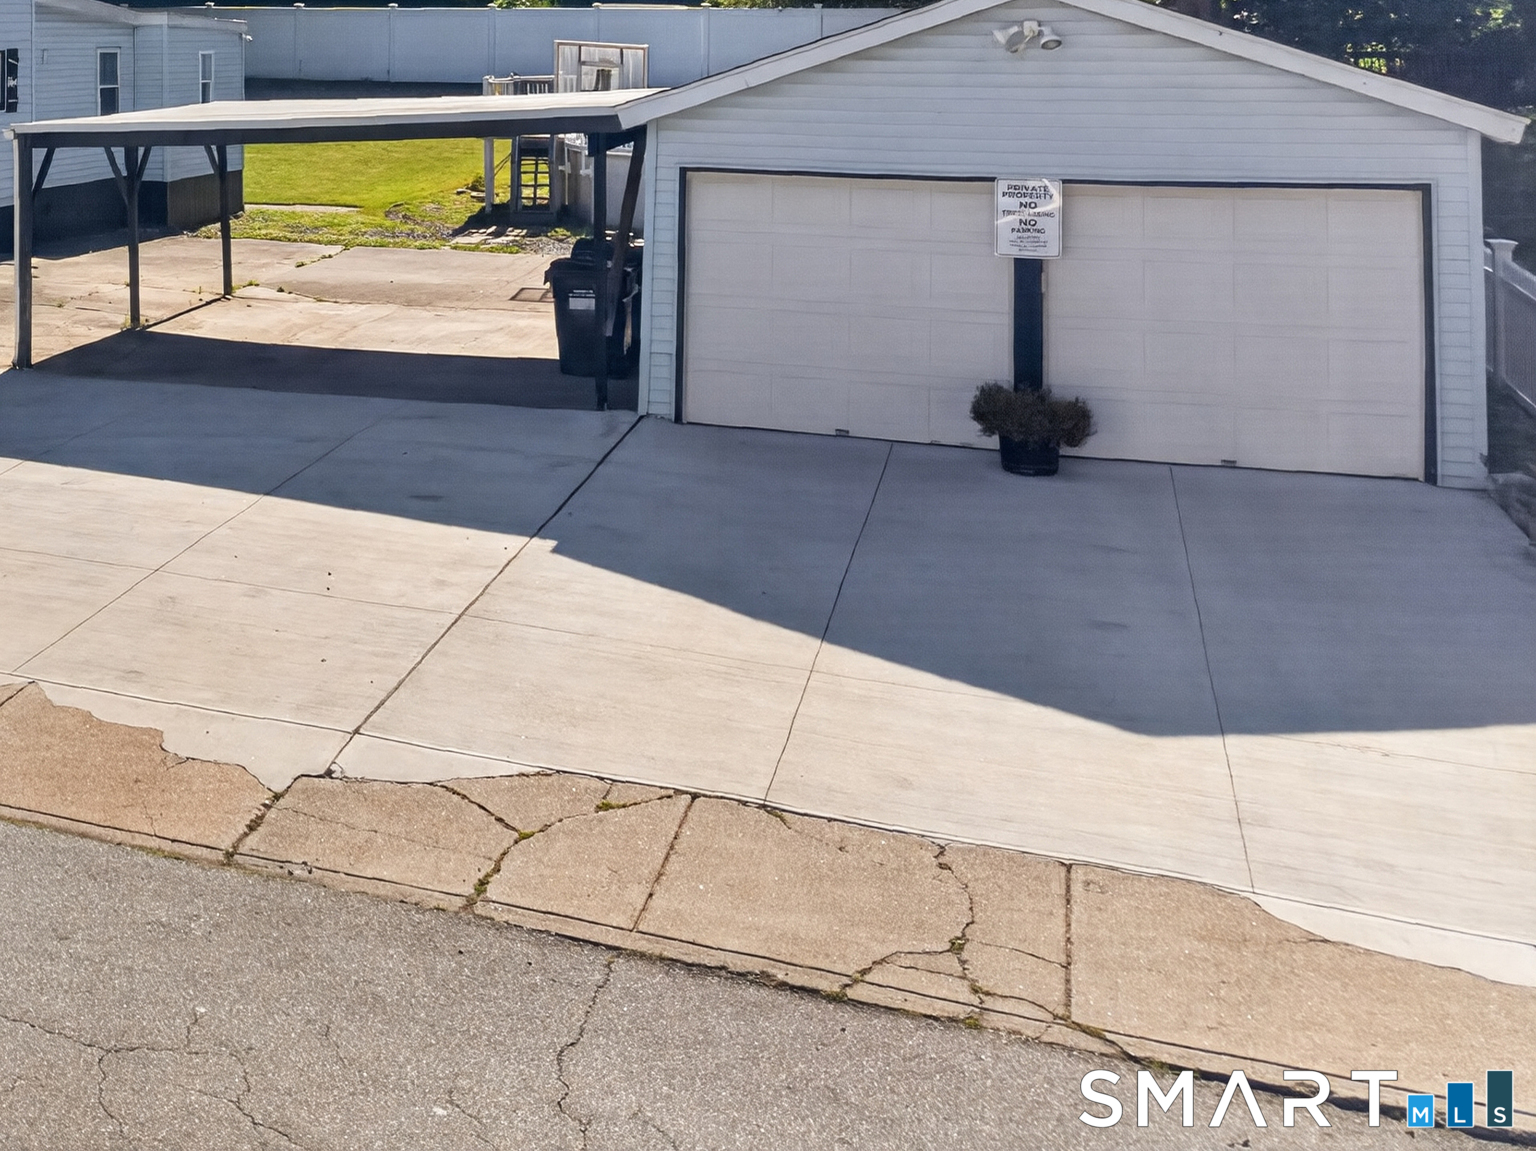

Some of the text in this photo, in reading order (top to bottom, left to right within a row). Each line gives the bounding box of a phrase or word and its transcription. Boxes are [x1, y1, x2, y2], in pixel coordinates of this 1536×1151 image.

[1007, 184, 1050, 193] PRIVATE
[1002, 191, 1054, 200] PROPERTY
[1019, 201, 1038, 209] NO
[1019, 218, 1038, 227] NO
